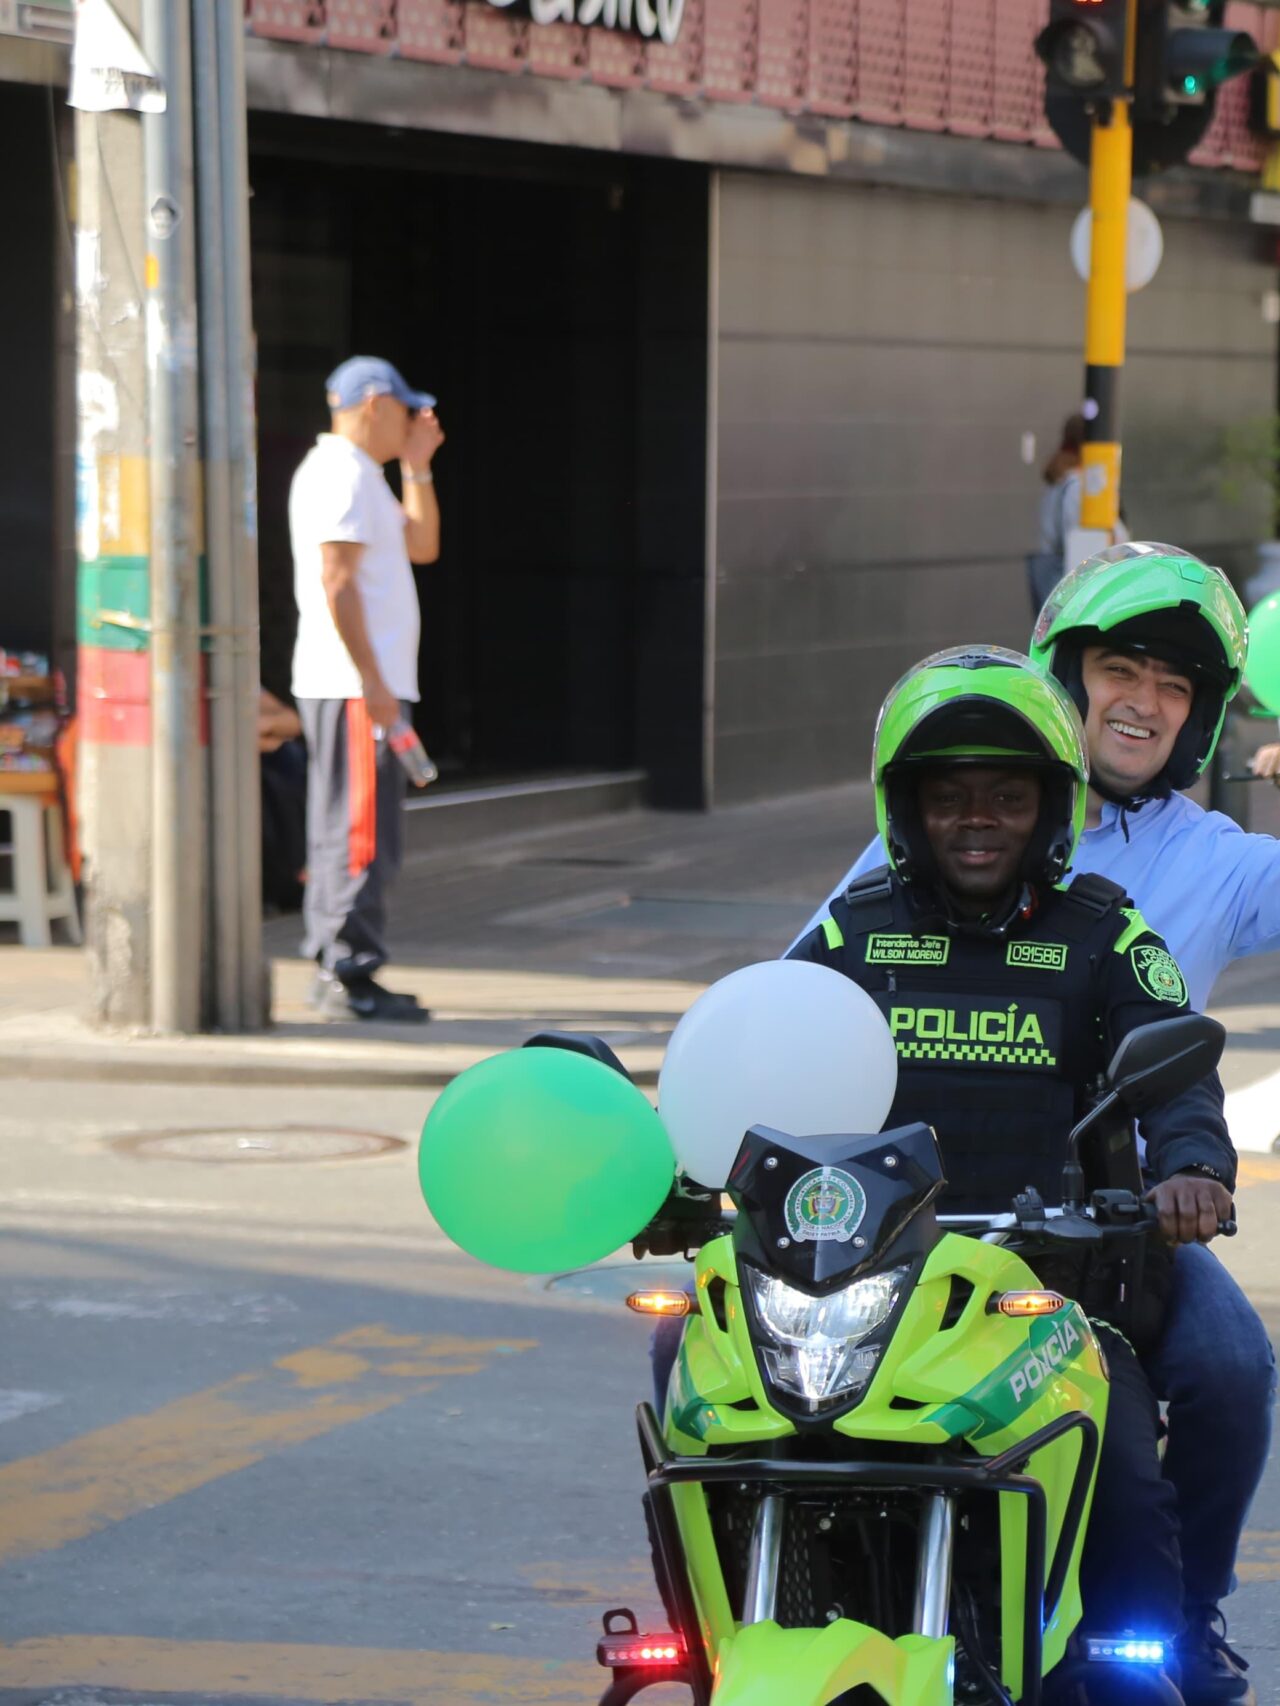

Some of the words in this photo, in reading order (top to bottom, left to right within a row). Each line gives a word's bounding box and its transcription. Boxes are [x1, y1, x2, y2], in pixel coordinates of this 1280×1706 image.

[921, 940, 942, 949] Jefe
[872, 949, 905, 959] WILSON
[906, 949, 943, 960] MORENO
[1012, 945, 1062, 965] 091586
[889, 1003, 1044, 1044] POLICÍA
